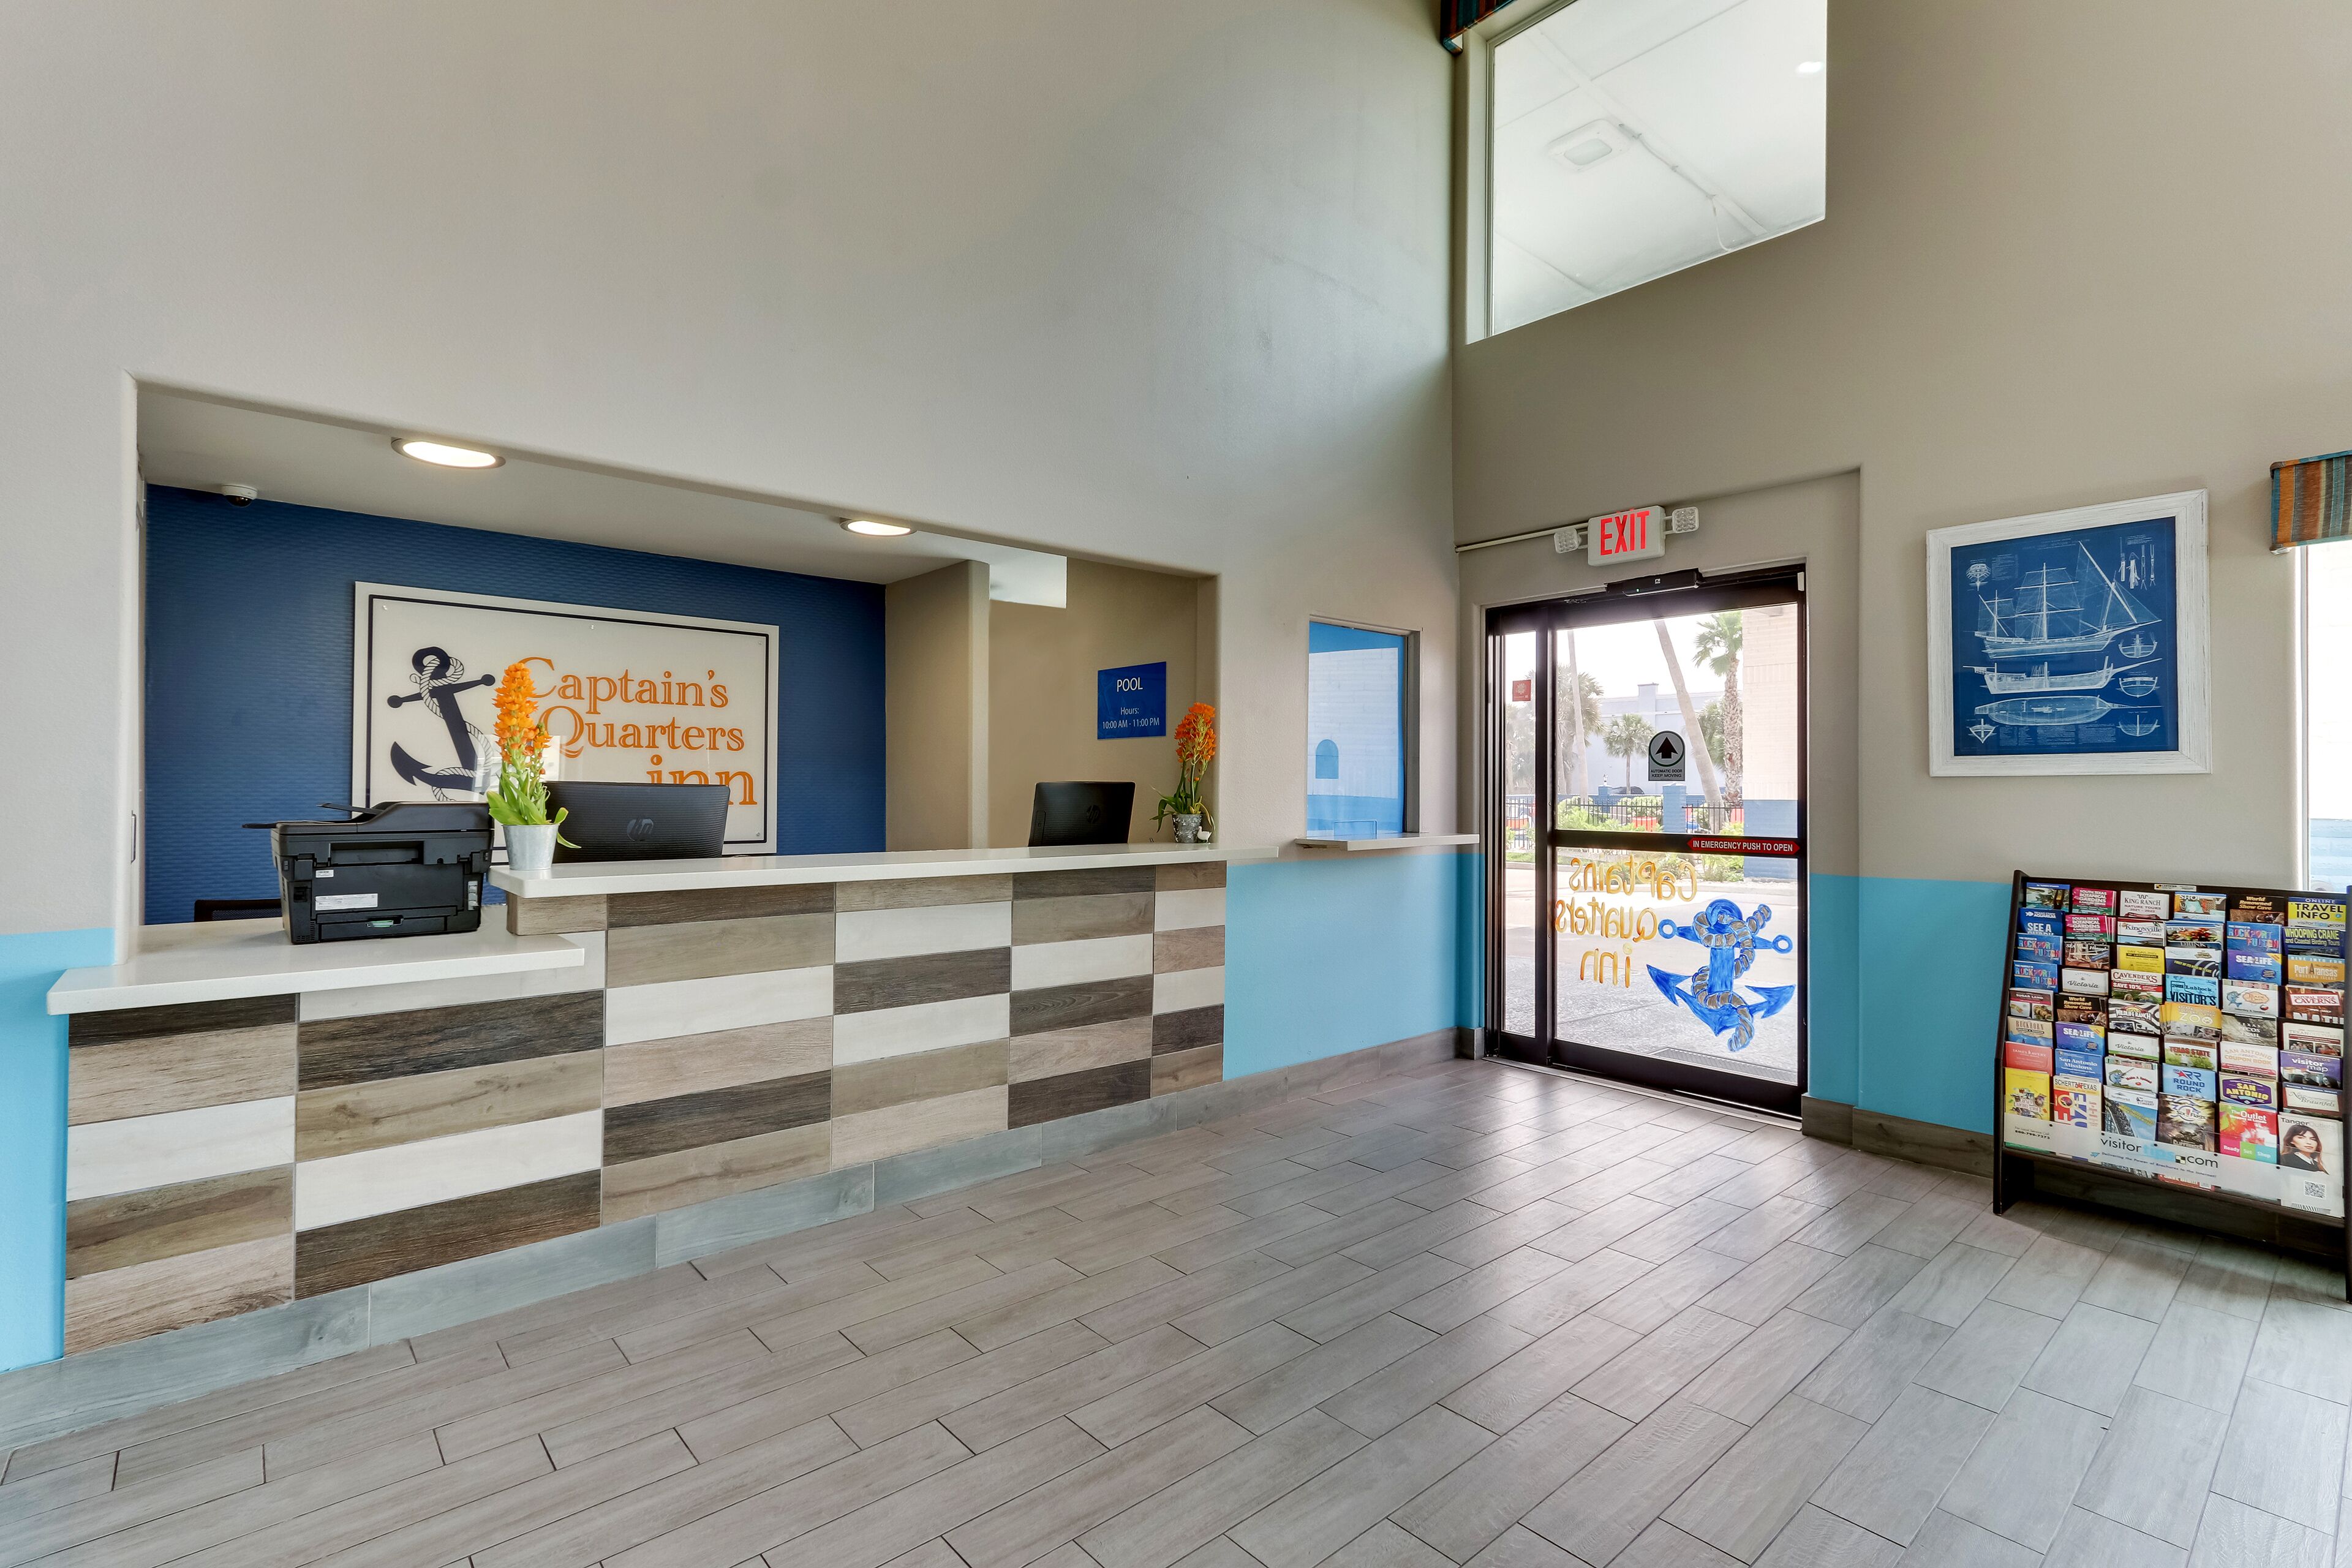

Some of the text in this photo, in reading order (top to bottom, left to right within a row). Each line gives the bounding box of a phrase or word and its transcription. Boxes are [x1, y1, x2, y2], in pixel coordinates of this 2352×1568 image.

[1600, 510, 1650, 556] EXIT
[518, 657, 729, 714] Captain's
[1117, 677, 1143, 692] POOL
[1102, 720, 1117, 729] 10:00
[1133, 718, 1148, 727] 11:00
[1150, 717, 1159, 726] PM
[538, 705, 745, 758] Quarters
[1701, 840, 1741, 850] EMERGENCY
[2296, 903, 2343, 913] TRAVEL
[2297, 911, 2330, 919] INFO
[2027, 922, 2051, 932] SEE A
[2125, 924, 2162, 934] Kingsville
[2228, 928, 2272, 939] ROCKPORT
[2285, 927, 2339, 940] WHOOPING CRANE
[2019, 940, 2054, 949] ROCKPORT
[2246, 938, 2278, 948] FULTON
[2034, 948, 2060, 957] FULTON
[2236, 955, 2253, 963] SEA
[2015, 968, 2051, 977] ROCKPORT
[2294, 965, 2308, 974] Port
[2309, 963, 2337, 977] Aransas
[2030, 976, 2057, 986] FULTON
[2113, 972, 2157, 983] CAVENDER'S
[2171, 990, 2217, 1006] VISITOR'S
[2116, 1009, 2151, 1020] WILDLIFE RANCH
[2016, 1021, 2044, 1030] BUCKHORN
[2191, 1048, 2211, 1057] STATE
[2241, 1050, 2272, 1060] ANTONIO
[2071, 1058, 2097, 1067] Antonio
[2291, 1058, 2324, 1067] visitor
[2307, 1065, 2328, 1073] map
[2174, 1078, 2205, 1088] ROUND
[2177, 1085, 2202, 1093] ROCK
[2226, 1088, 2269, 1100] ANTONIO
[2301, 1098, 2335, 1107] Braunfels
[2241, 1110, 2267, 1121] Outlet
